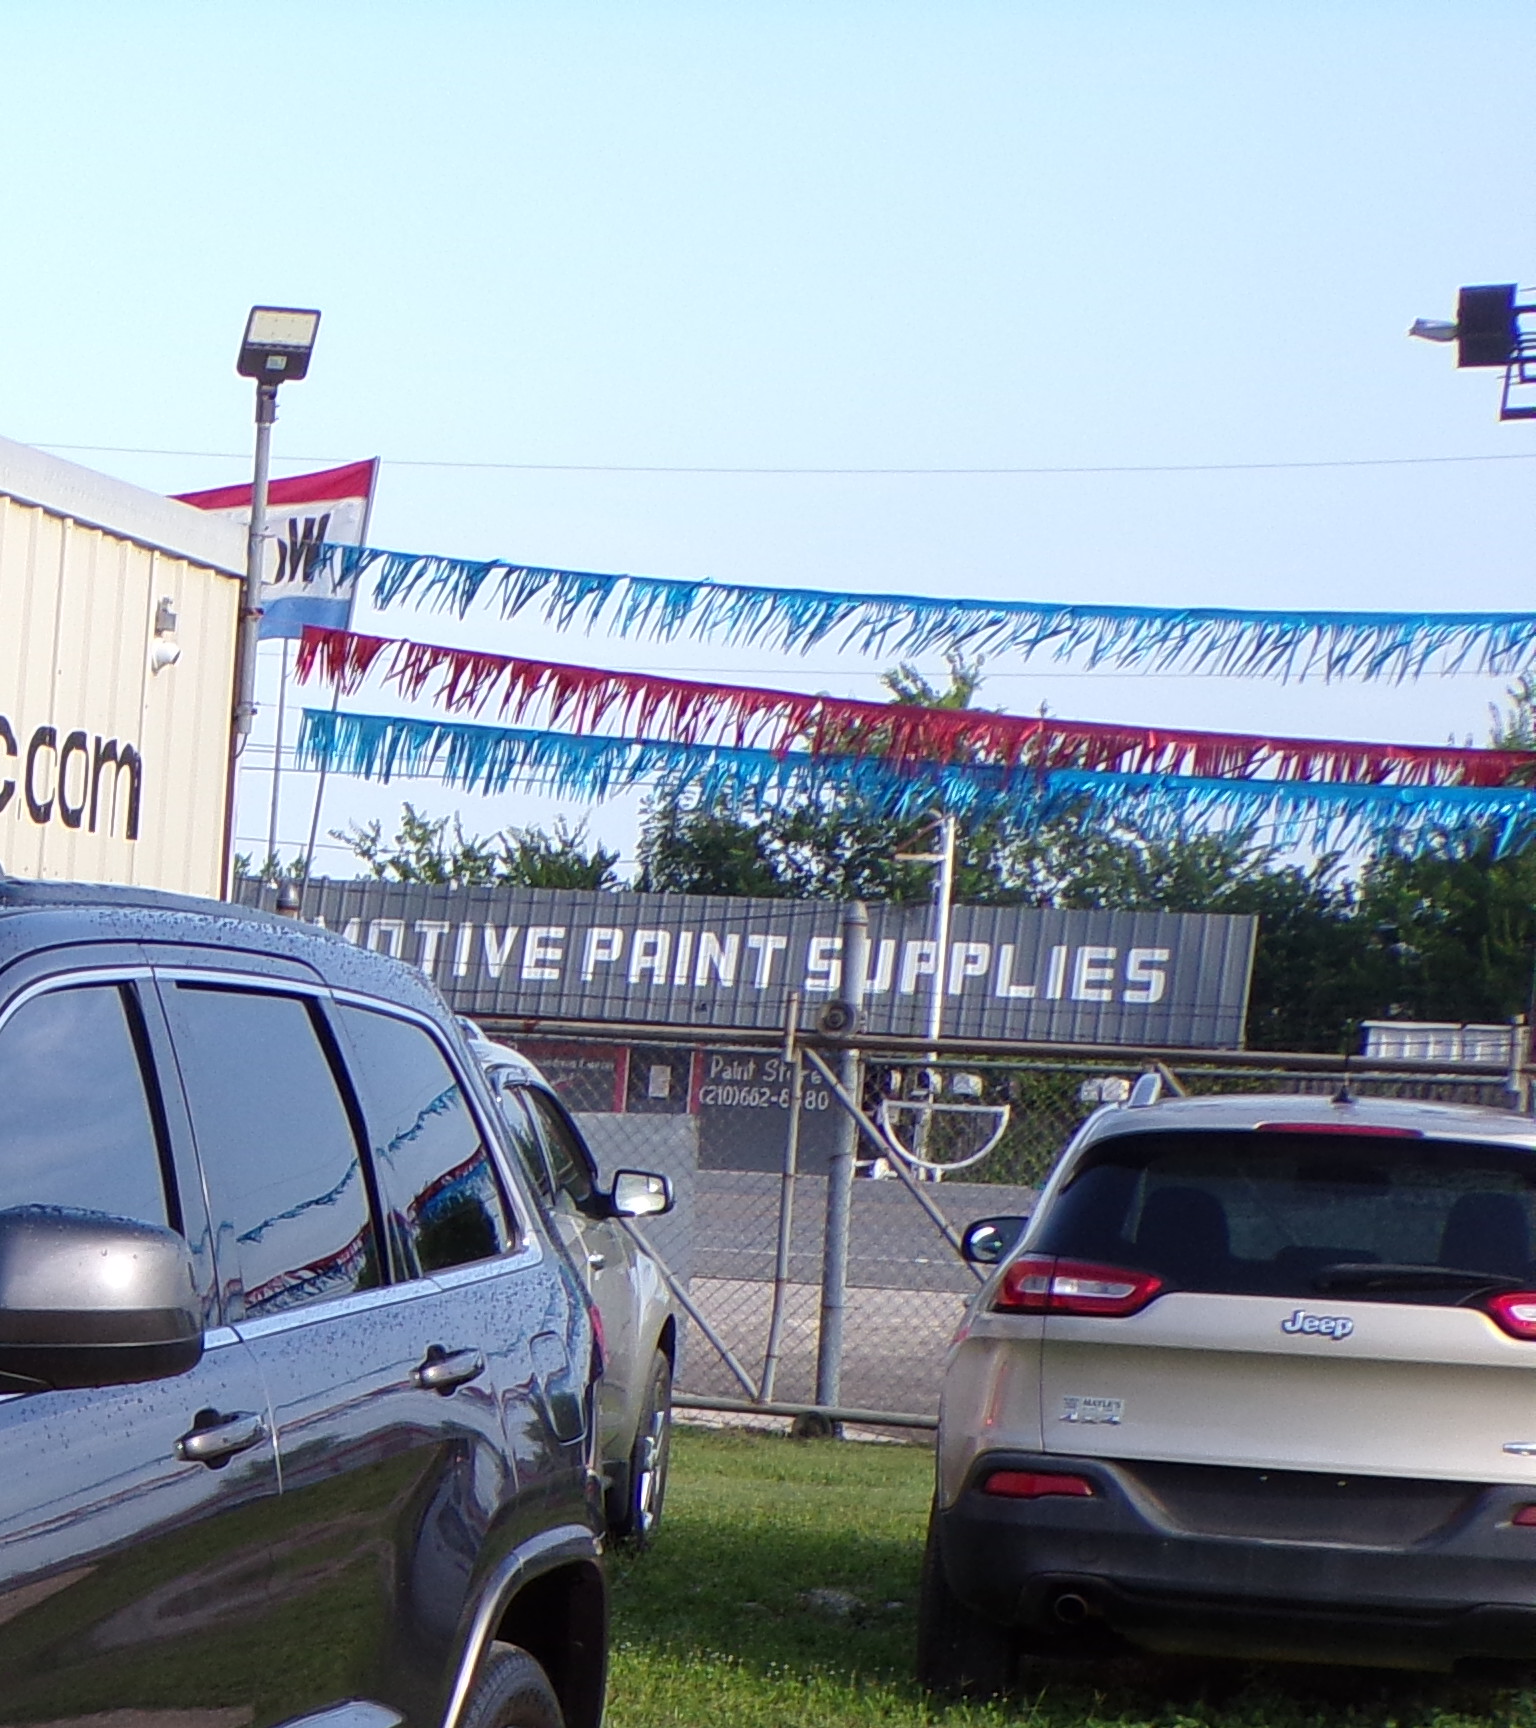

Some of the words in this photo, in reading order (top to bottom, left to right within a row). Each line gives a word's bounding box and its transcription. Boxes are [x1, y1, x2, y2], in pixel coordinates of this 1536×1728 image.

[580, 926, 787, 989] PAINT
[805, 936, 1170, 1004] SUPPLIES
[710, 1055, 757, 1081] Paint
[698, 1085, 830, 1111] (210)662-880
[1282, 1310, 1354, 1340] Jeep
